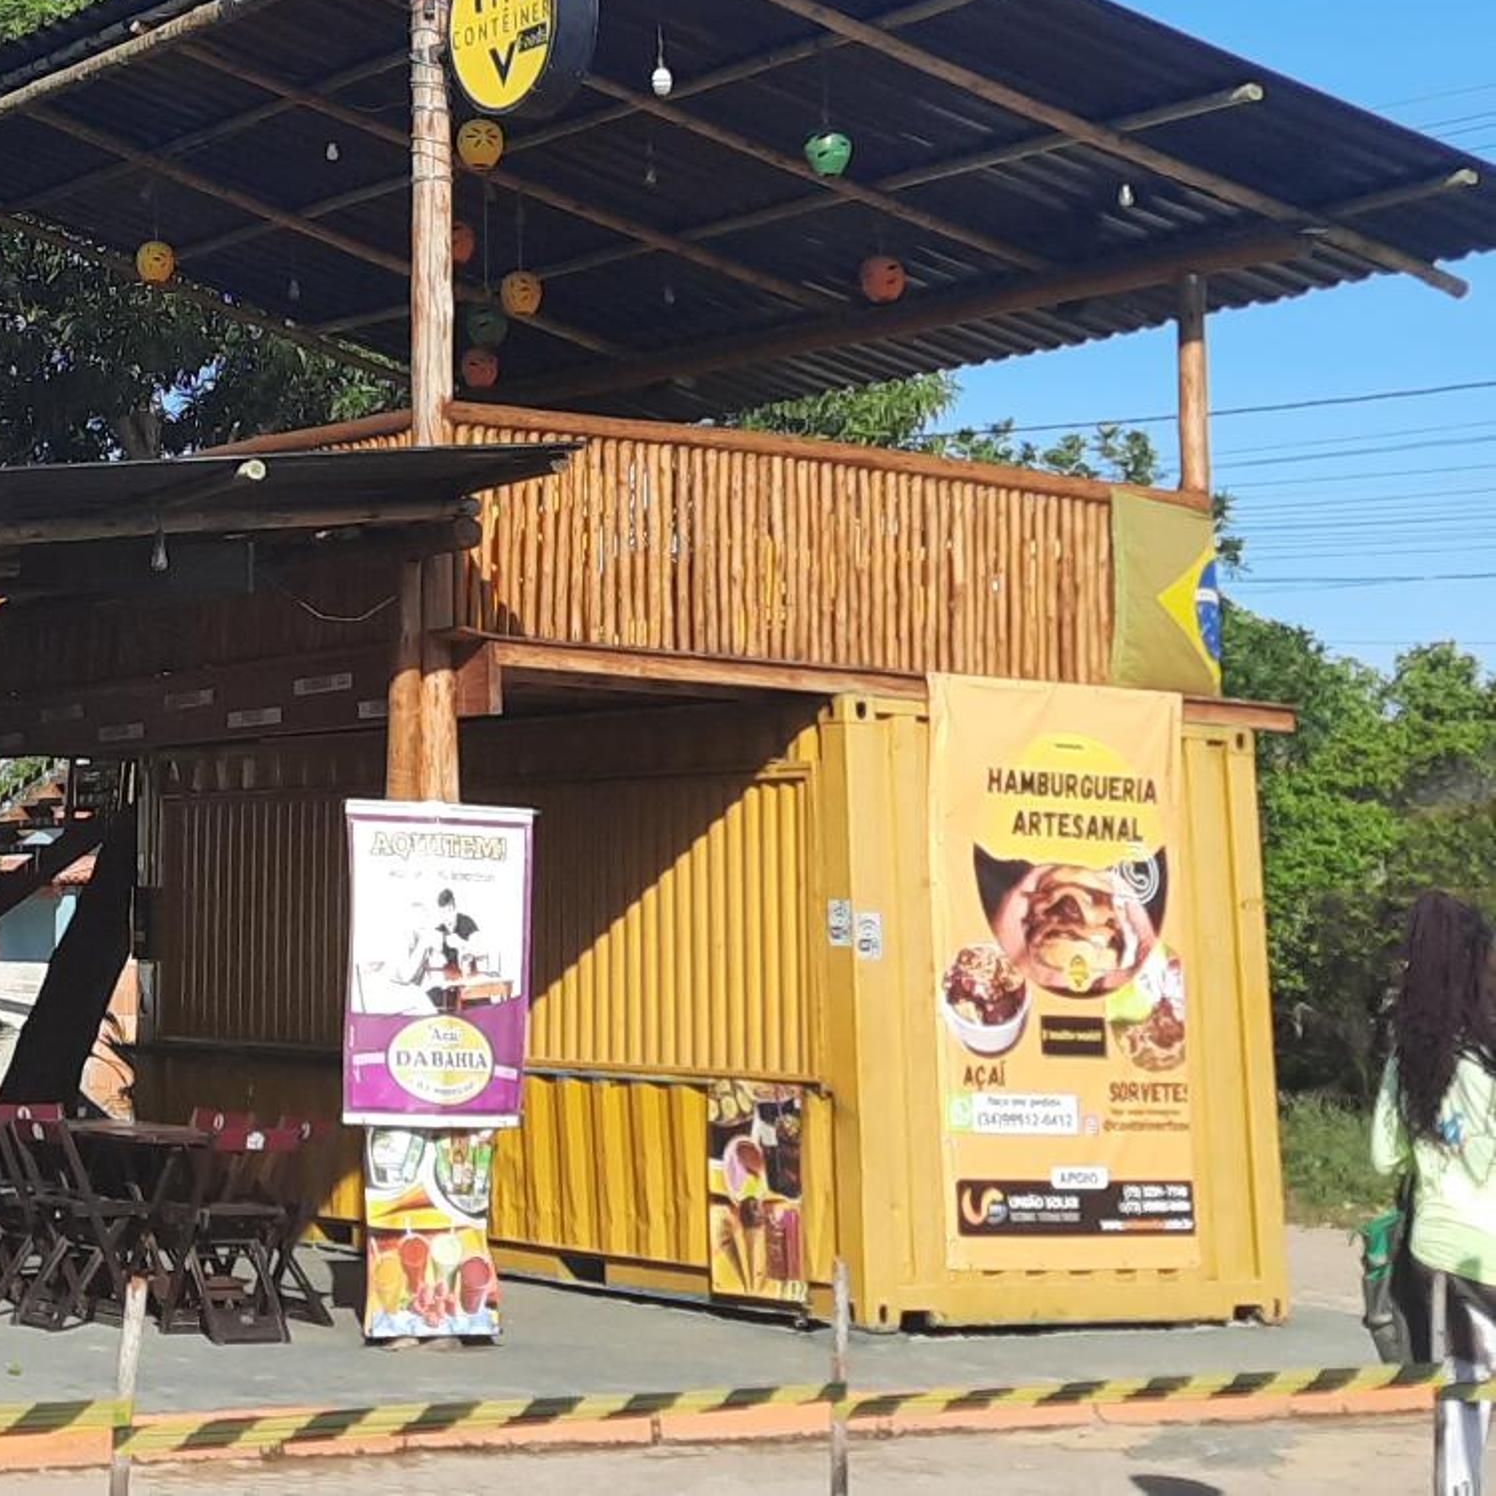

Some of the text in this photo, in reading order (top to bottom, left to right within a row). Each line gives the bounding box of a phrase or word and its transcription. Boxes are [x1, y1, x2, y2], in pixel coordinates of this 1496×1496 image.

[987, 767, 1157, 805] HAMBURGUERIA
[1012, 810, 1144, 842] ARTESANAL
[963, 1060, 1006, 1091] AÇAÍ
